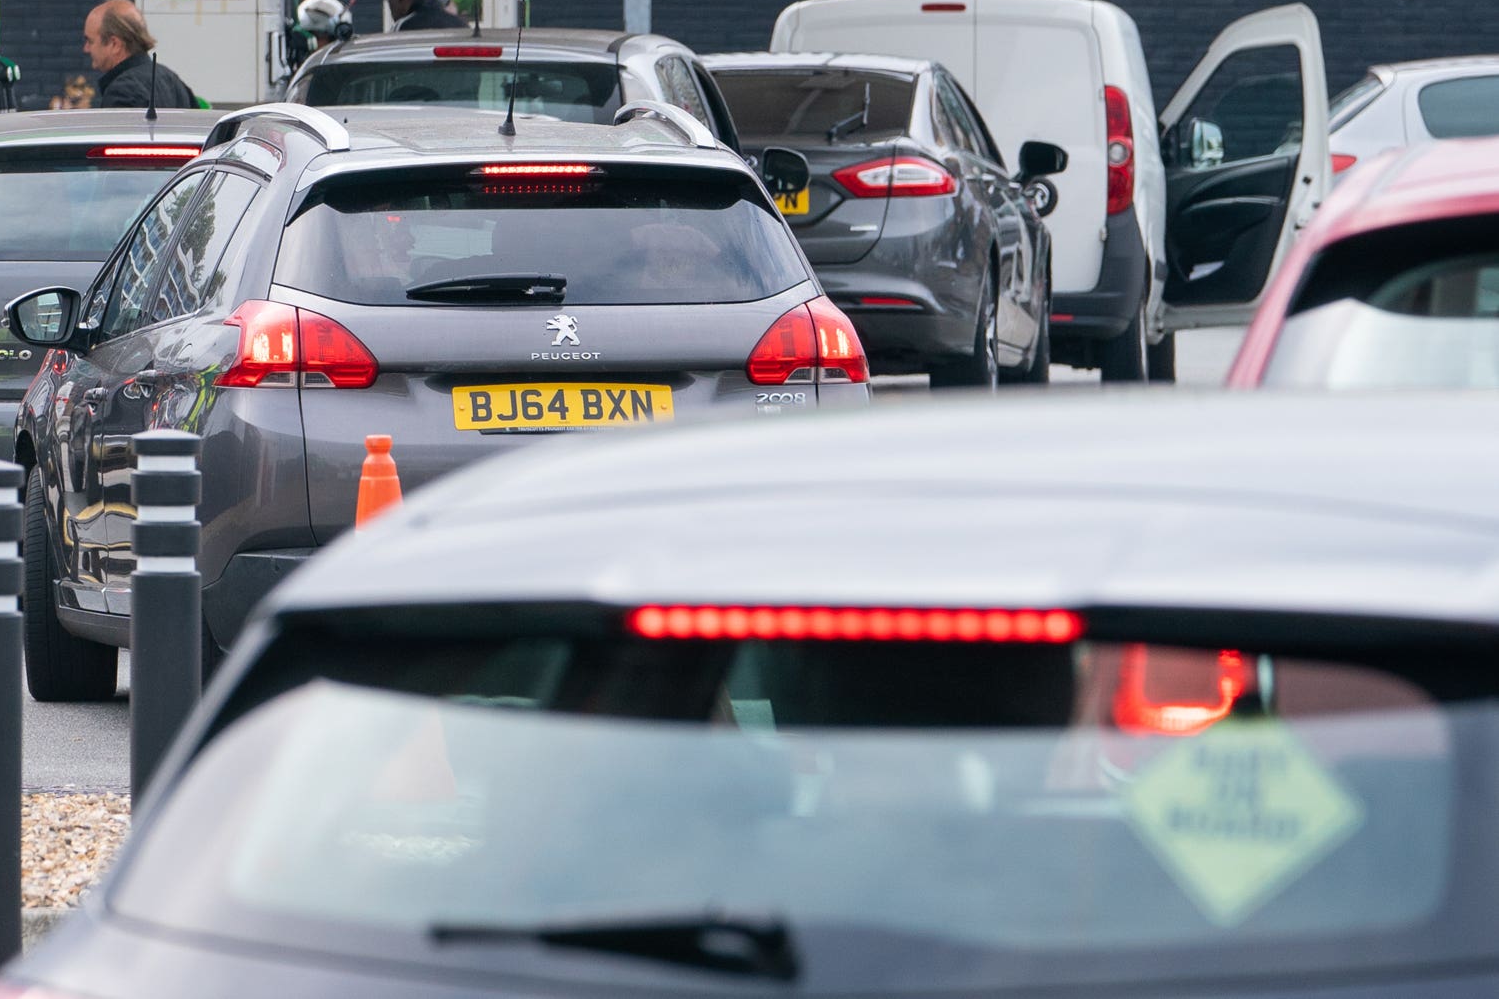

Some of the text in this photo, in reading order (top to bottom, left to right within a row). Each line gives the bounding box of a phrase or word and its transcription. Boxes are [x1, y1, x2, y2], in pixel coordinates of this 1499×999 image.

[531, 352, 601, 361] PEUGEOT
[755, 392, 806, 404] 2008
[469, 388, 655, 423] BJ64 BXN
